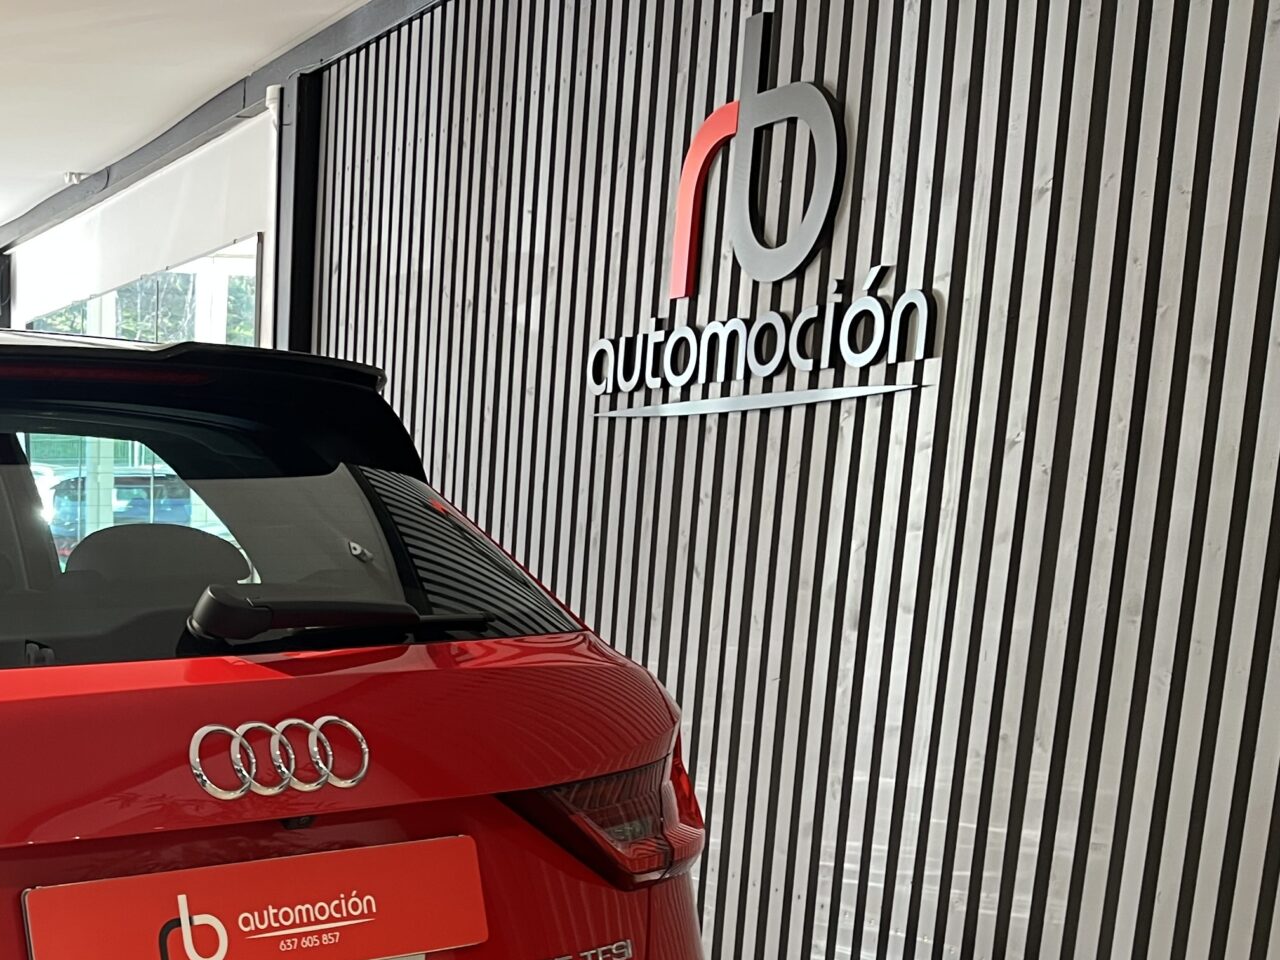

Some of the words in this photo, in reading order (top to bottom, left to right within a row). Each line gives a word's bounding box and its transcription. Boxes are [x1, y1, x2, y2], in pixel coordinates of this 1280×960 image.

[587, 265, 928, 395] automoción
[238, 890, 377, 932] automoción
[279, 938, 298, 951] 637
[301, 935, 320, 948] 605
[322, 932, 340, 945] 857
